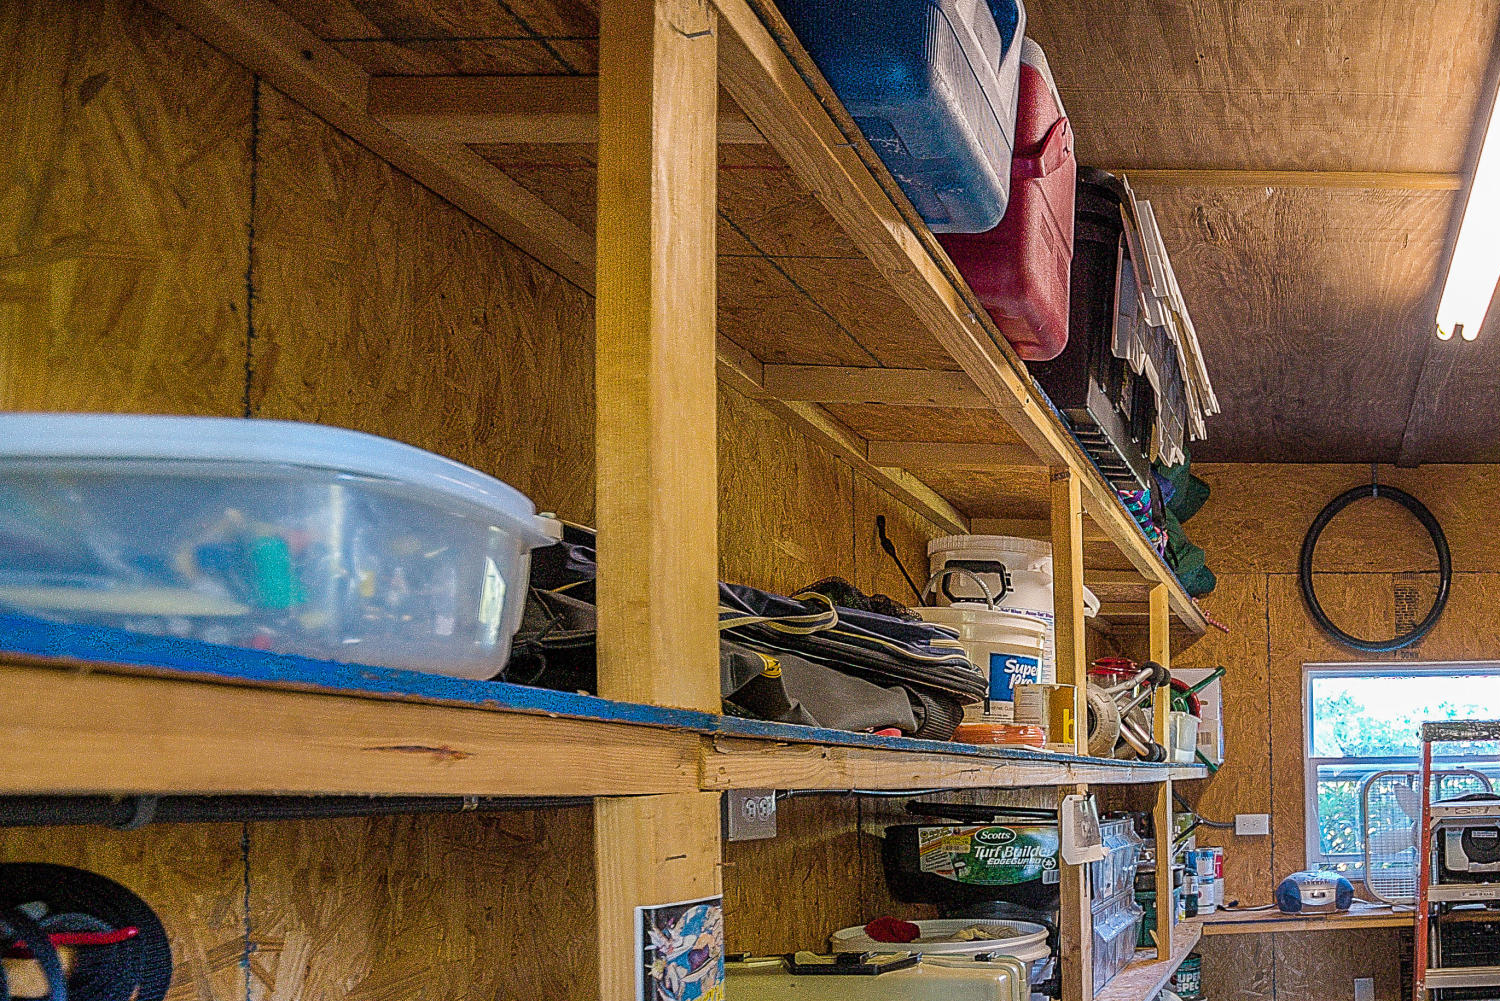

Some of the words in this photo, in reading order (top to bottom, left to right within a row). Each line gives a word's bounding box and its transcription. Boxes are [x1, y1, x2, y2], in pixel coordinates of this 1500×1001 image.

[1004, 659, 1038, 677] Supe
[980, 831, 1012, 840] Scotts
[974, 845, 1002, 859] Turf
